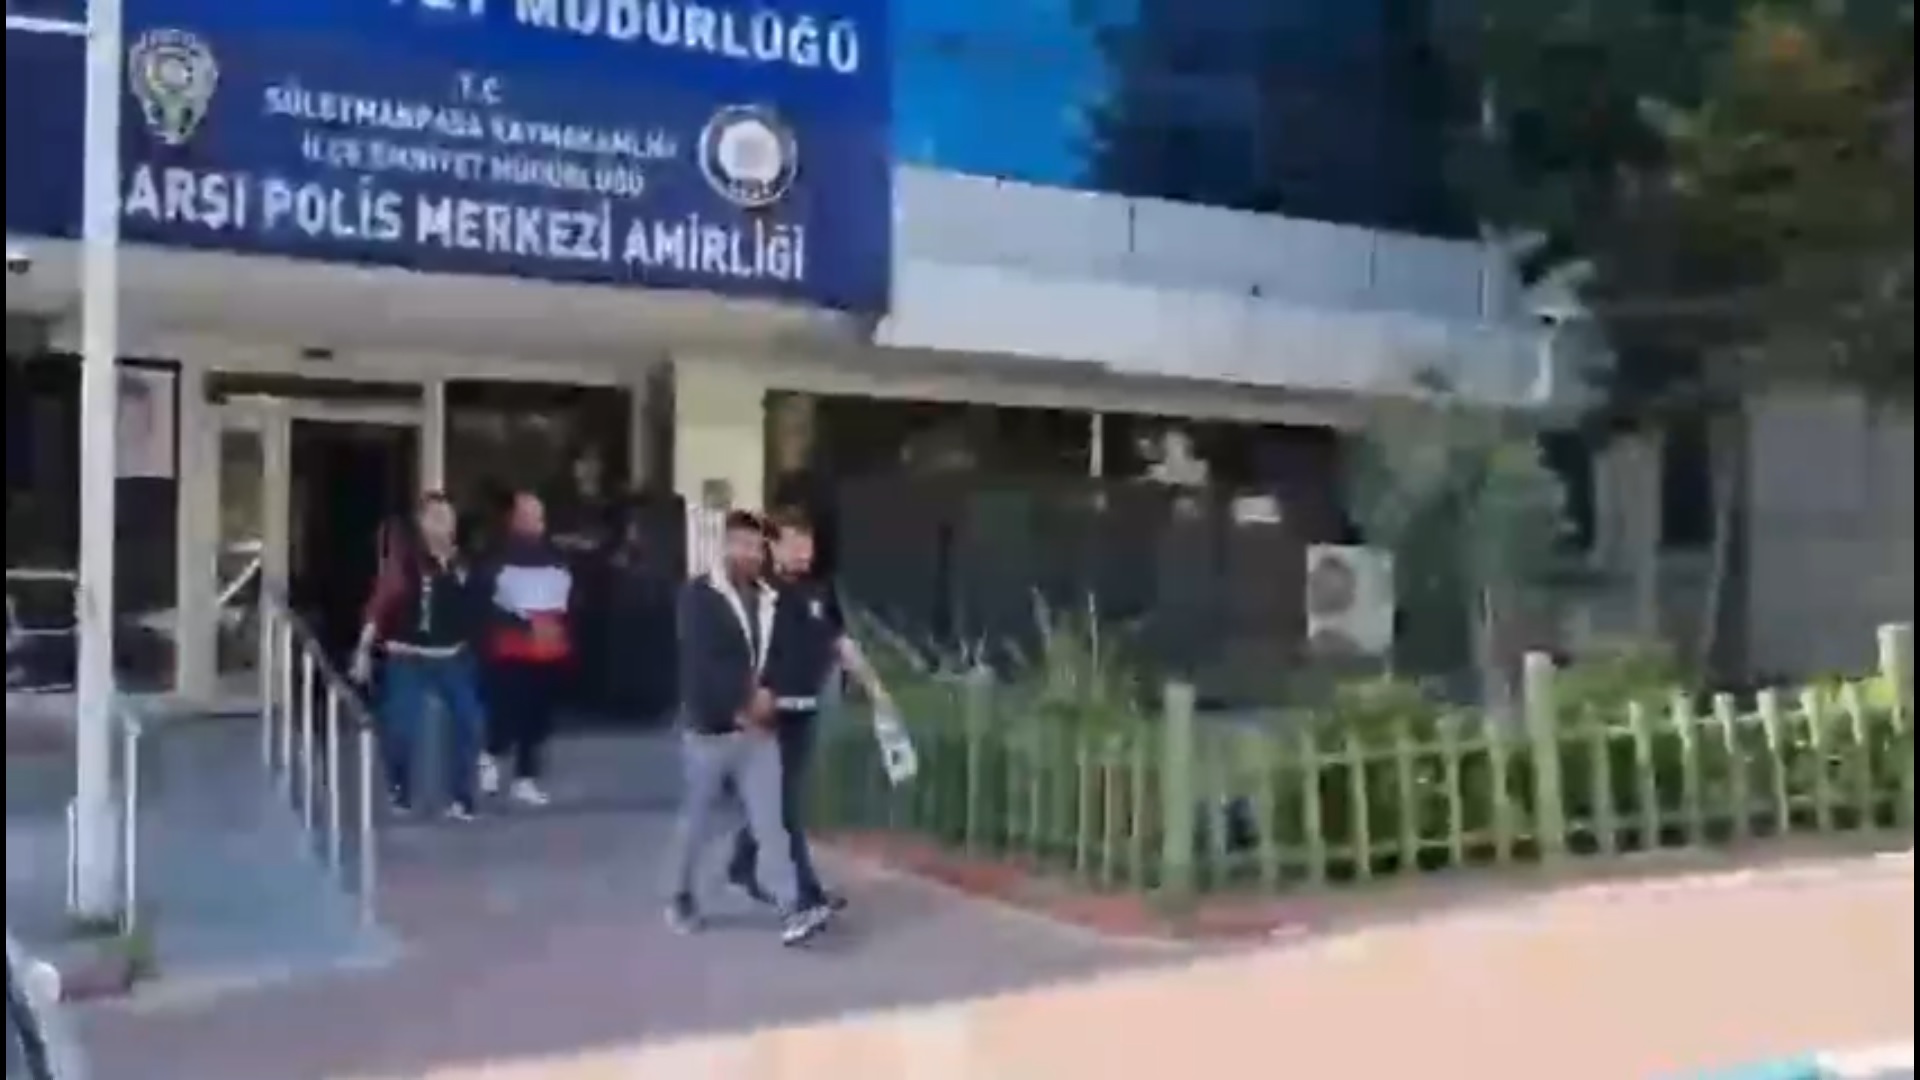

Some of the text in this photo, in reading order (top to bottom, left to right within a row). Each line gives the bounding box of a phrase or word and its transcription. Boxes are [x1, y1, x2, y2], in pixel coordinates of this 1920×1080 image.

[123, 163, 804, 281] ARŞI POLİS MERKEZİ AMİRLİĞİ
